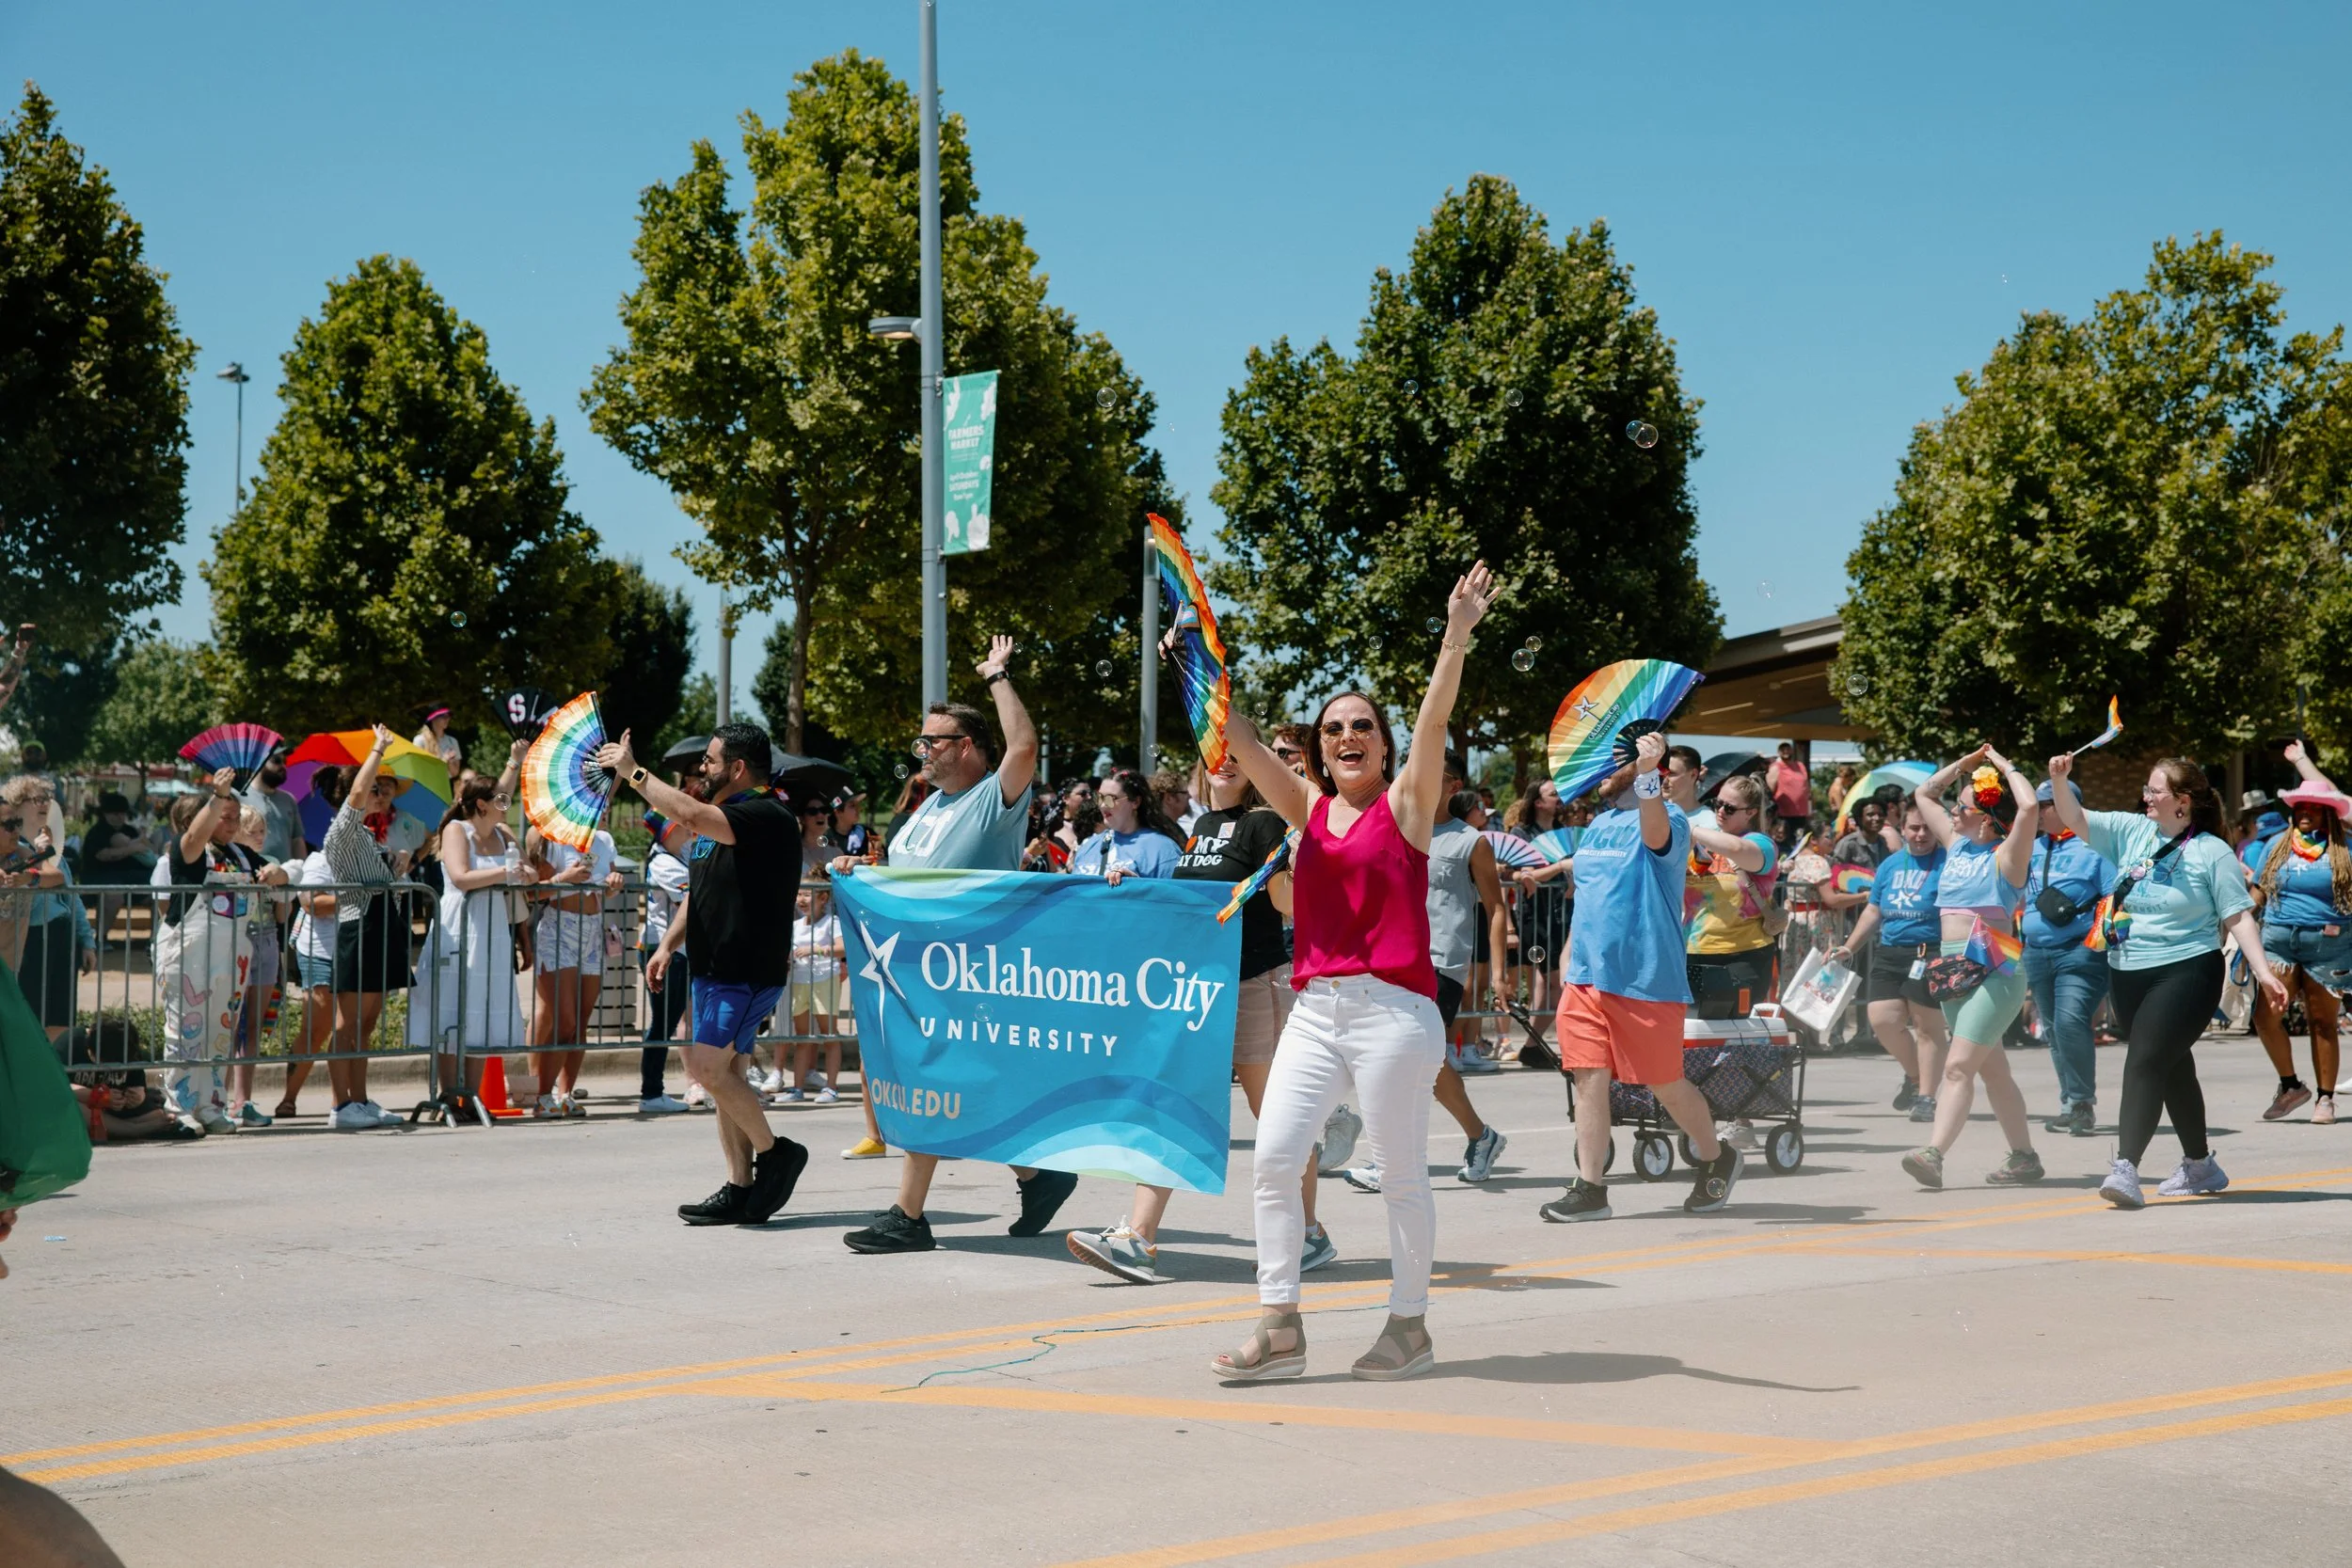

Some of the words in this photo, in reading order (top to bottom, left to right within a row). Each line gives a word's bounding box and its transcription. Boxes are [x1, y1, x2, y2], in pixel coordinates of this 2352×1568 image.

[1175, 854, 1193, 867] AY
[1192, 854, 1223, 867] DOG
[1194, 834, 1230, 854] MY
[921, 942, 1130, 1007] Oklahoma
[1136, 958, 1225, 1032] City
[920, 1017, 1118, 1056] UNIVERSITY
[871, 1078, 961, 1119] OKCU.EDU
